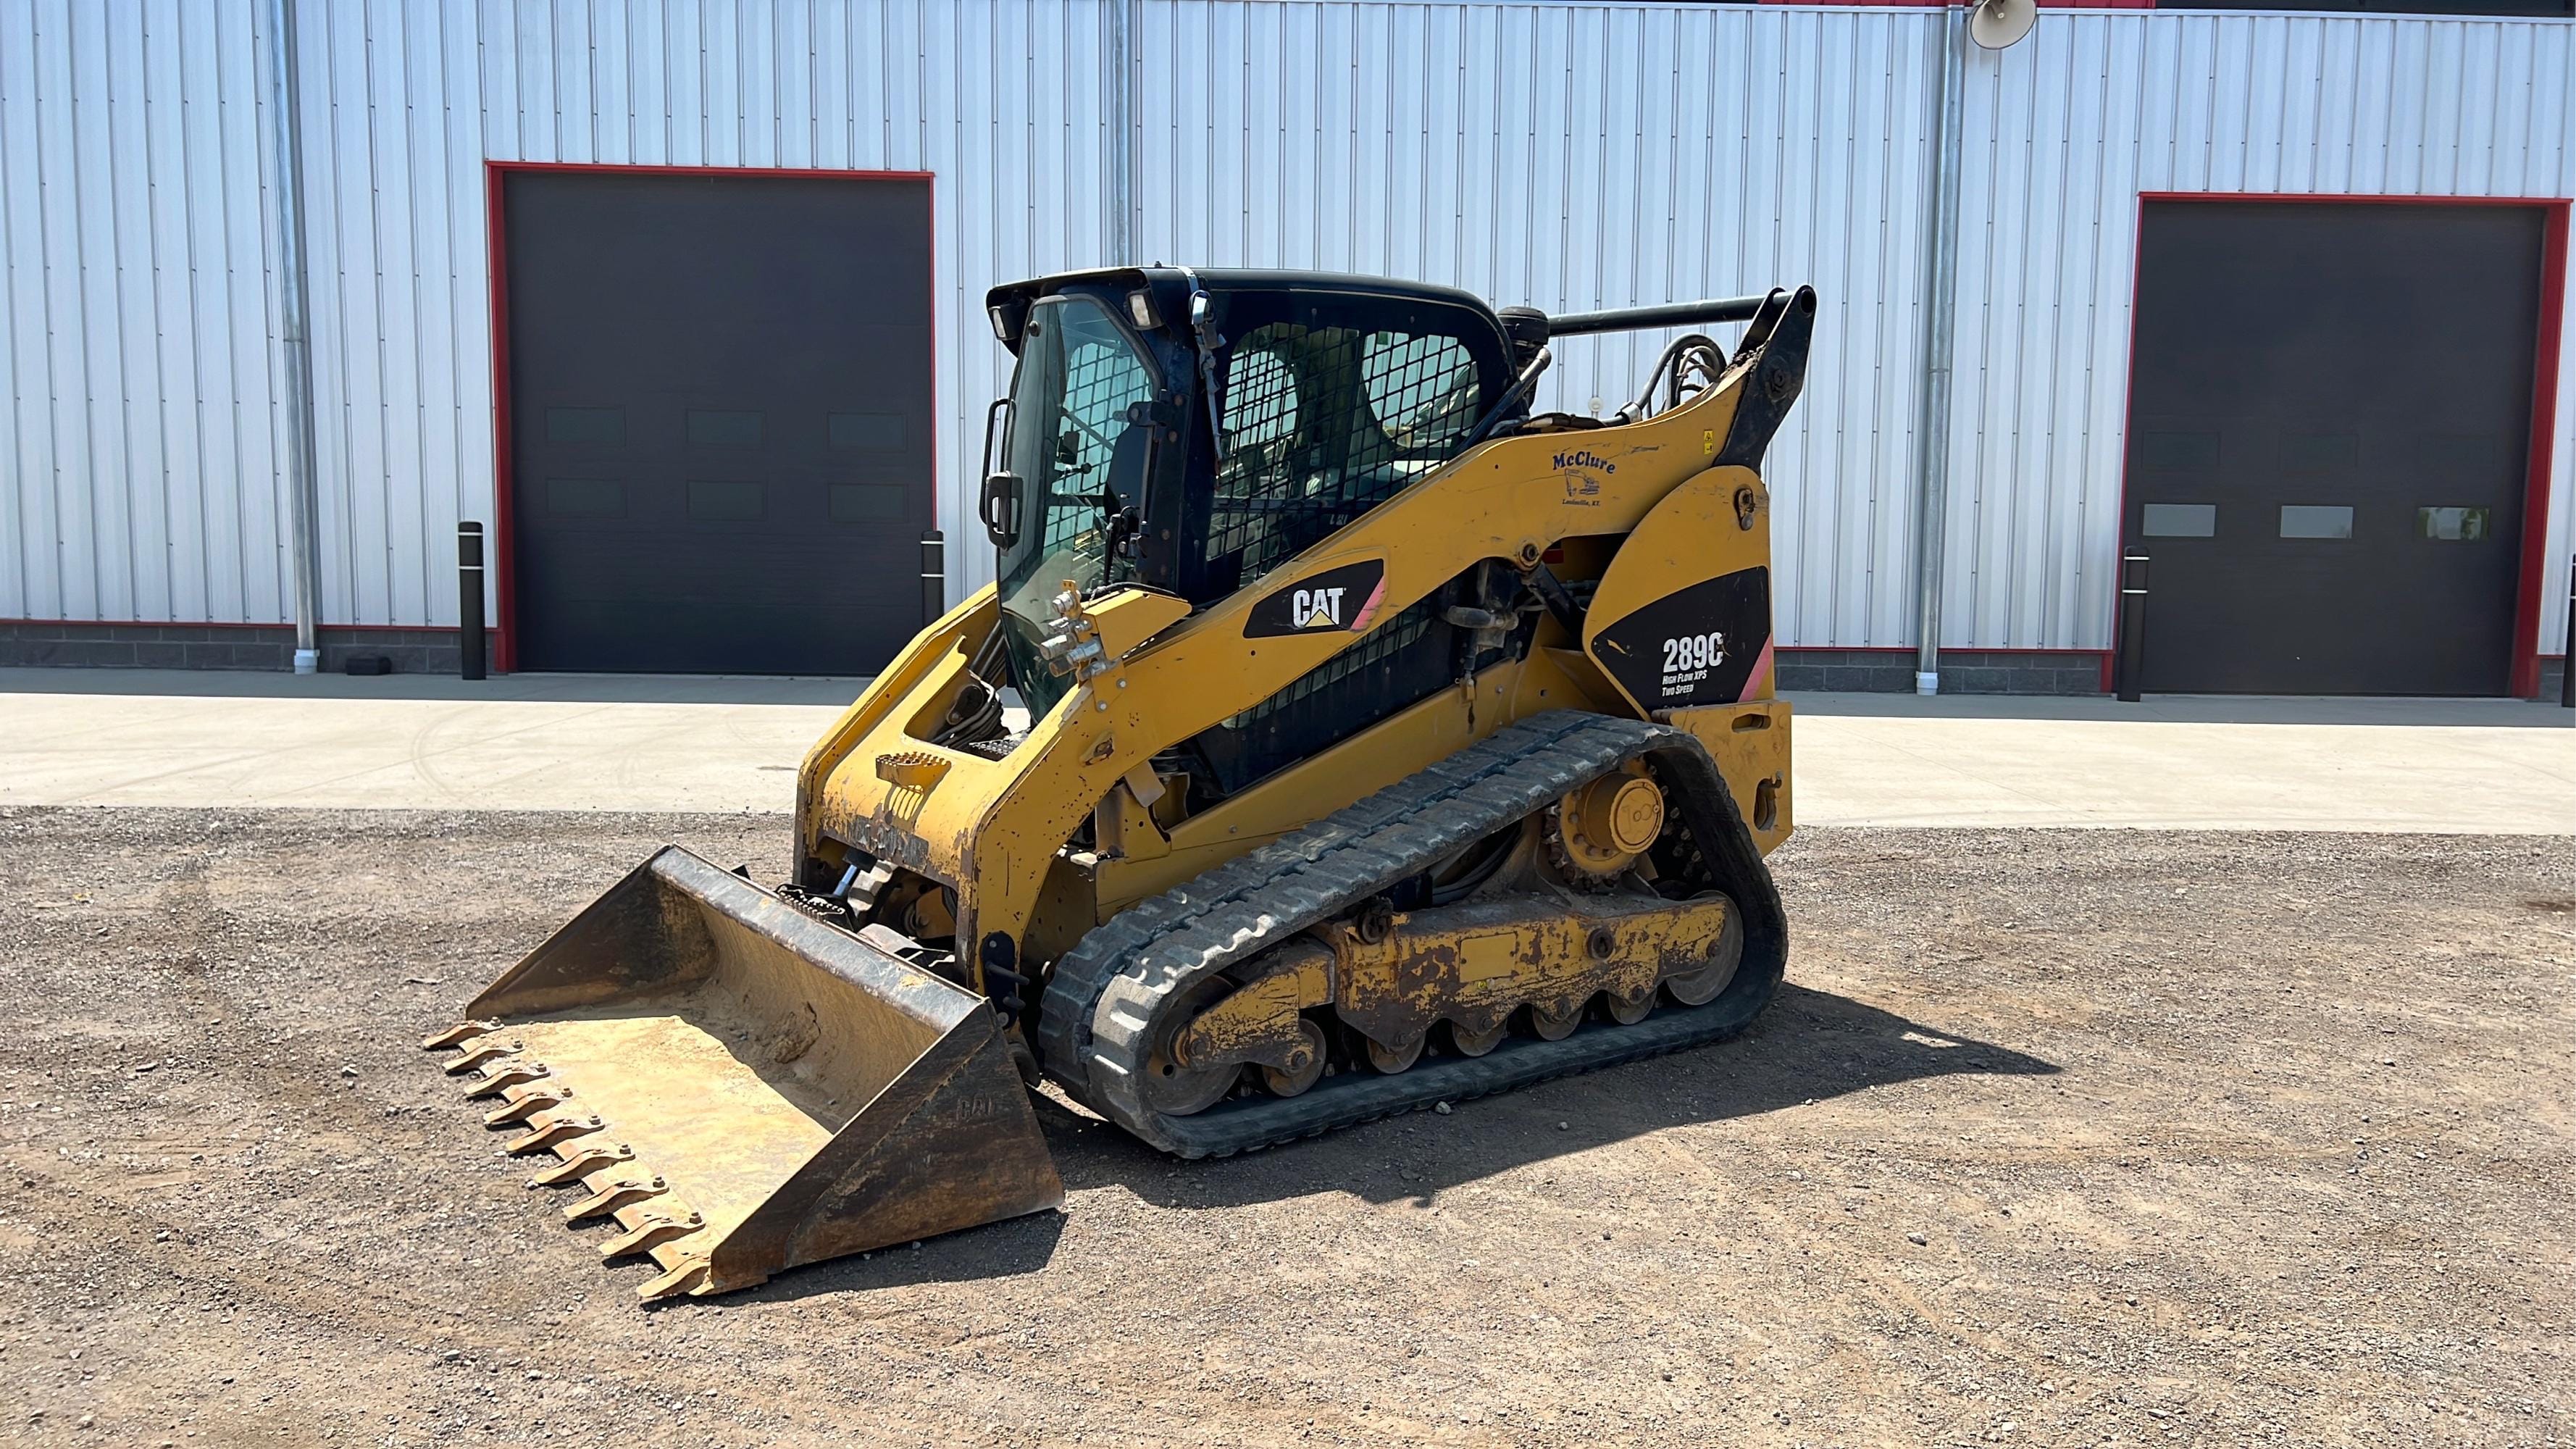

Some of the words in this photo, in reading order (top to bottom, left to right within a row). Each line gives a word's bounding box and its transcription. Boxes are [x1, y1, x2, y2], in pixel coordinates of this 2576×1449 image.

[1552, 451, 1615, 474] McClure
[1293, 588, 1344, 628] CAT
[1663, 632, 1723, 673] 289C
[1694, 669, 1707, 680] XPS
